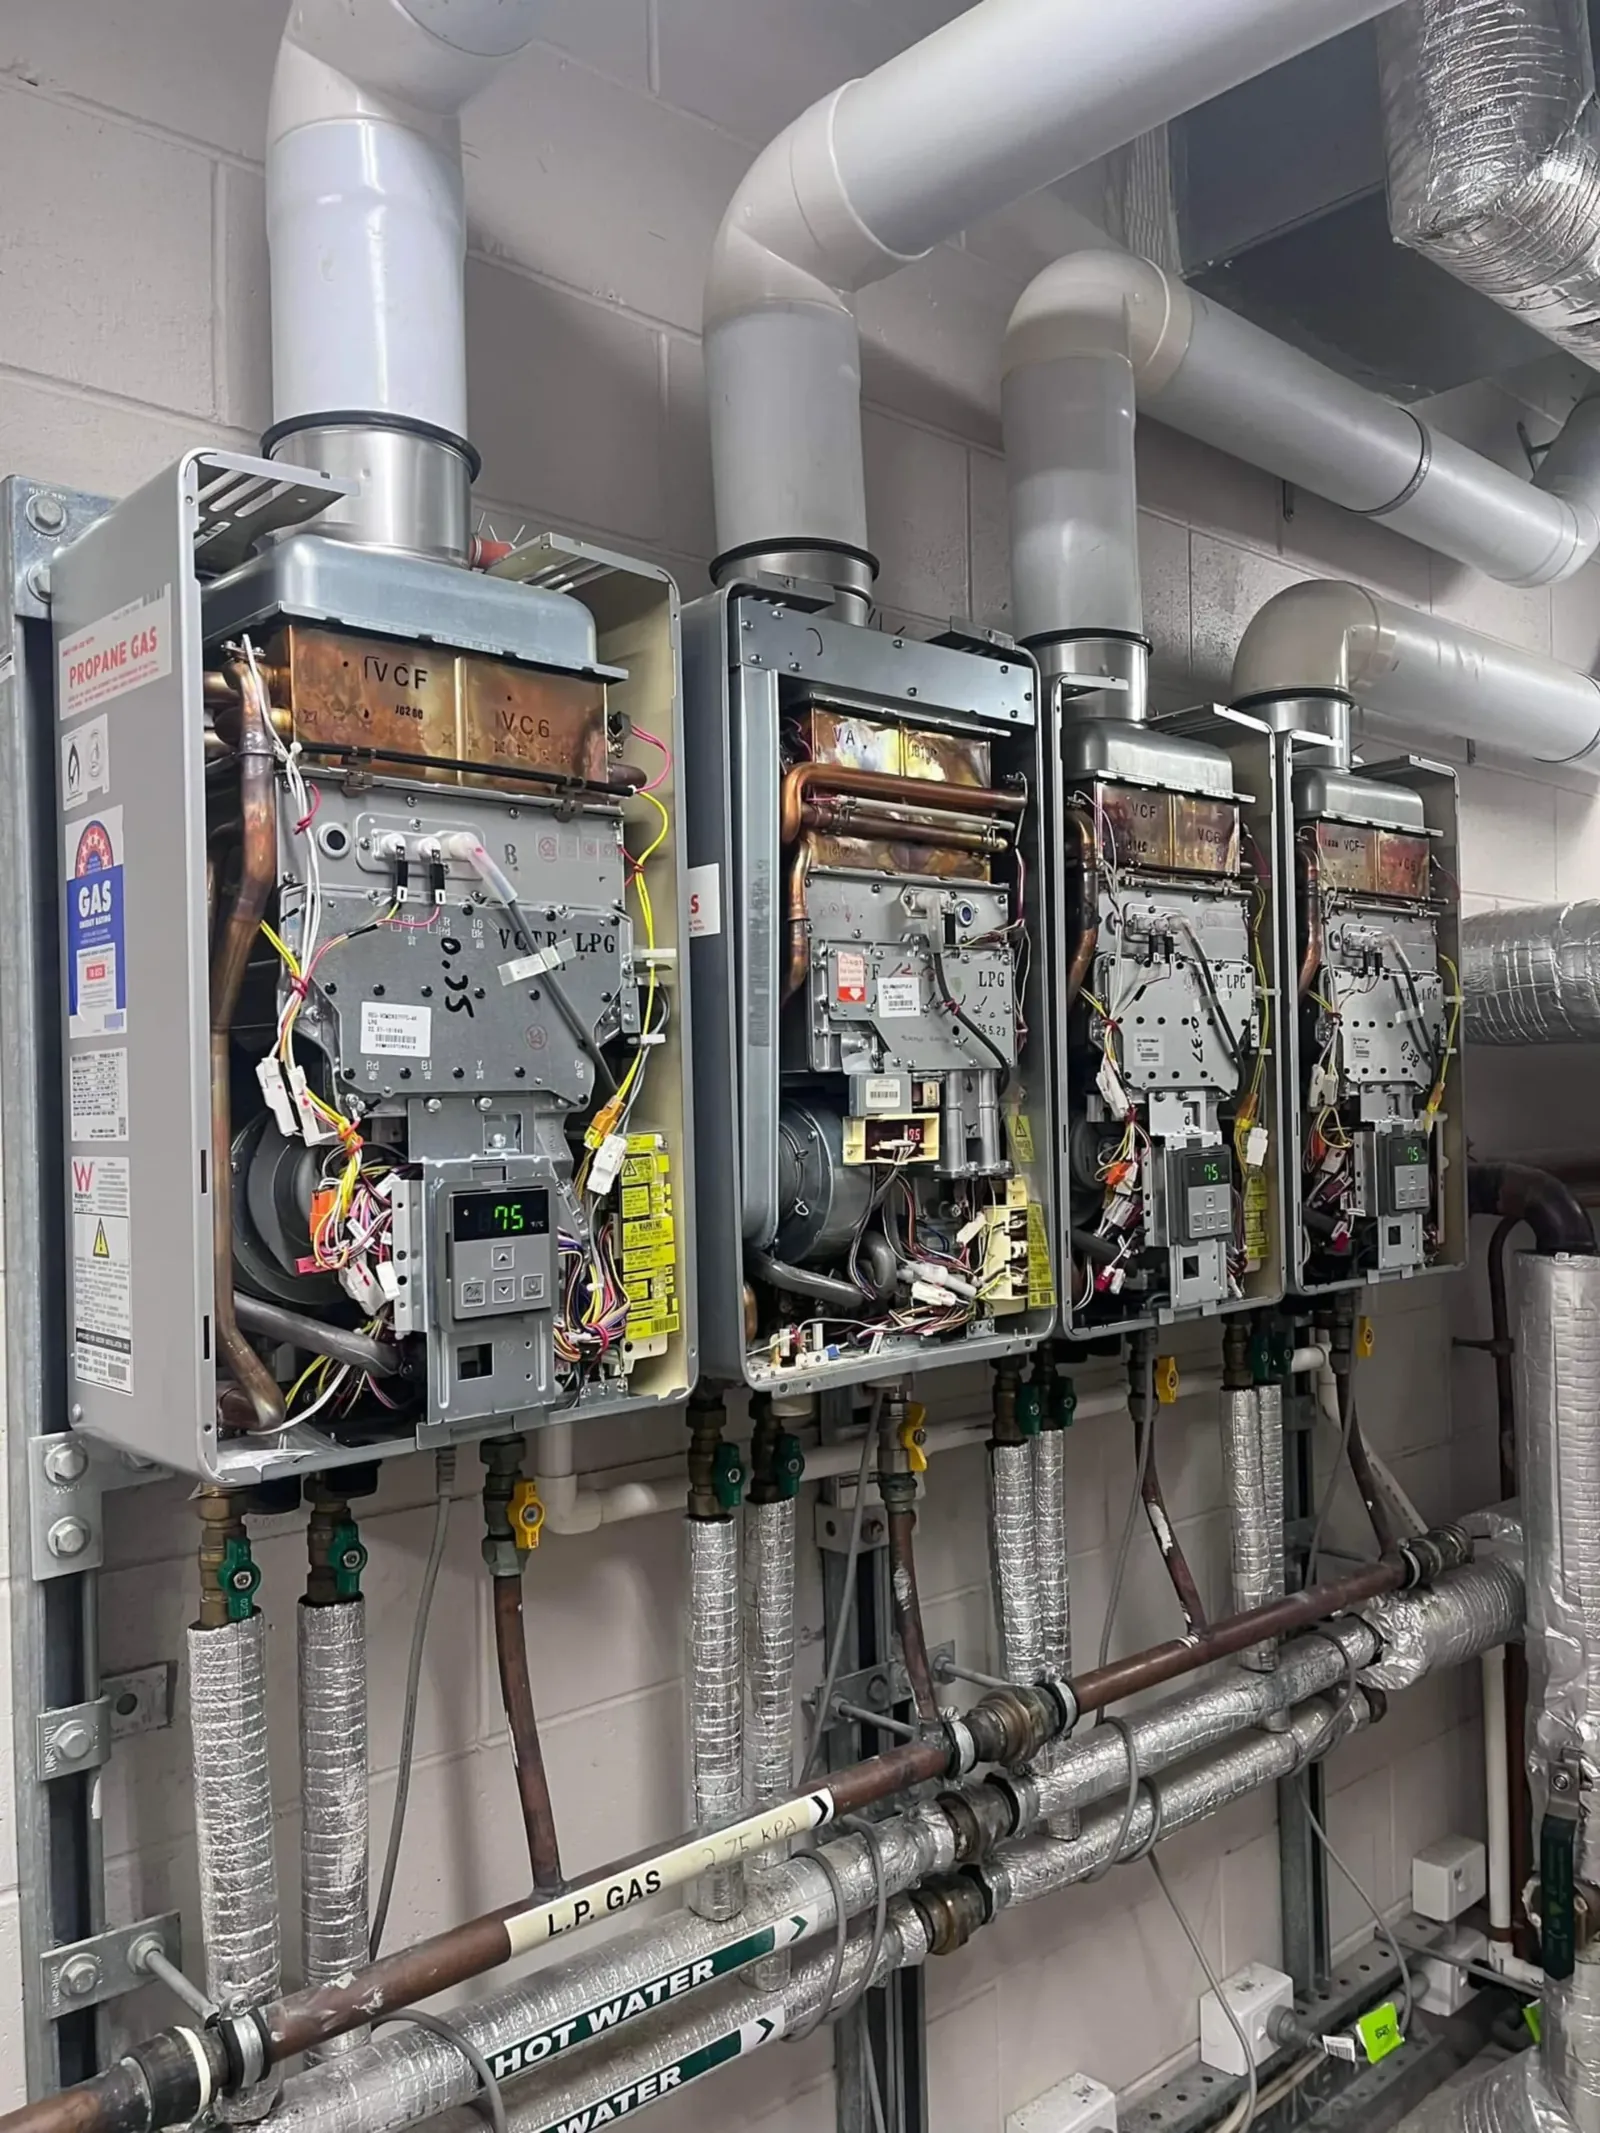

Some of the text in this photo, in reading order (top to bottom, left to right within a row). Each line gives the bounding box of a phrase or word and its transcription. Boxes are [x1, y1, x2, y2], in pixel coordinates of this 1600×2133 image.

[69, 641, 127, 689] PROPANE
[131, 626, 158, 660] GAS
[373, 659, 429, 690] VCF
[502, 711, 551, 739] VC6
[1131, 804, 1157, 819] VCF
[78, 880, 112, 918] GAS
[575, 931, 615, 954] LPG
[978, 970, 1006, 987] LPG
[1226, 974, 1246, 989] LPG
[1408, 1146, 1420, 1162] 75
[1204, 1163, 1219, 1181] 75
[494, 1204, 524, 1230] 75
[548, 1869, 662, 1938] L.P. GAS
[494, 1958, 715, 2079] HOT WATER
[556, 2065, 683, 2133] WATER
